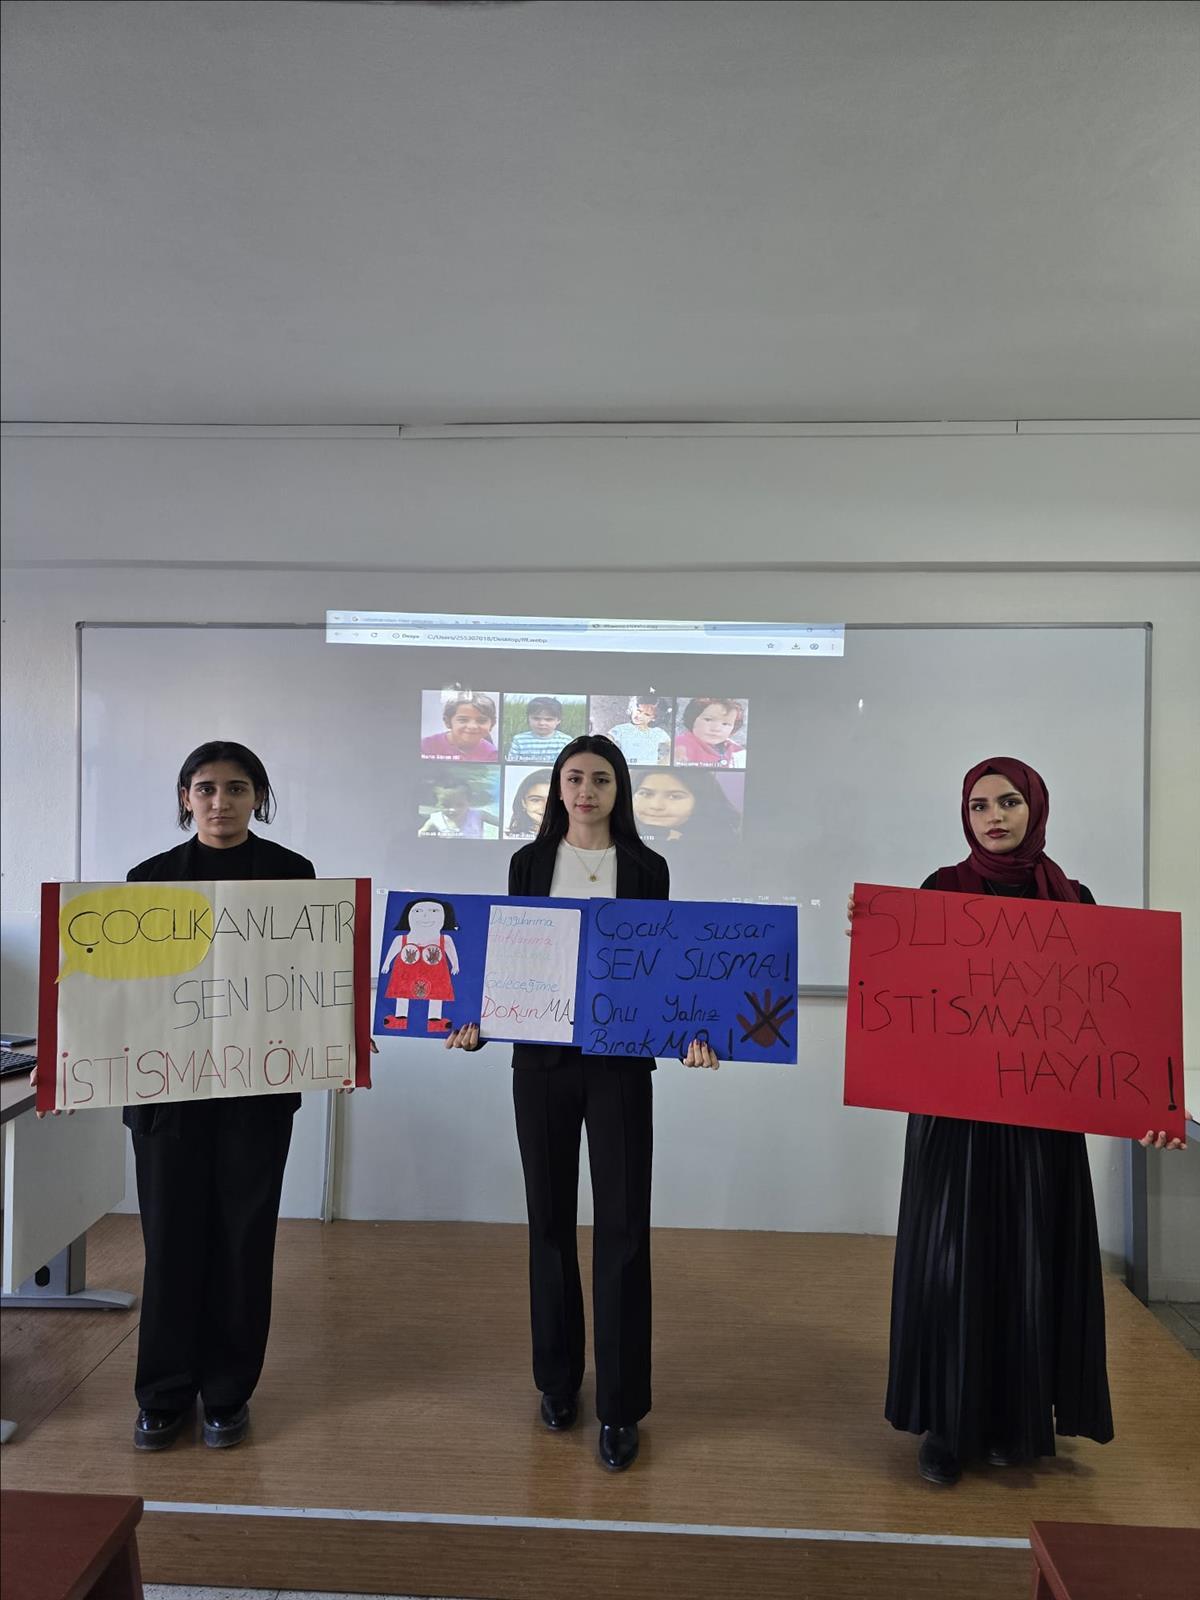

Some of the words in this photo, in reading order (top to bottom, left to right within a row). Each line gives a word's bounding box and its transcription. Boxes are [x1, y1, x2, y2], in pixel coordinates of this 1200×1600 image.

[68, 907, 212, 953] ÇOCUK
[210, 901, 355, 944] ANLATIR
[595, 902, 678, 940] Çocuk
[694, 921, 775, 941] susar
[868, 890, 1077, 957] SUSMA
[588, 947, 661, 980] SEN
[968, 958, 1131, 1008] HAYKIR
[173, 977, 249, 1030] SEN
[265, 966, 353, 1012] DİNLE
[592, 992, 638, 1025] Onu
[858, 981, 1106, 1045] İSTİSMARA
[62, 1045, 252, 1106] İSTİSMARI
